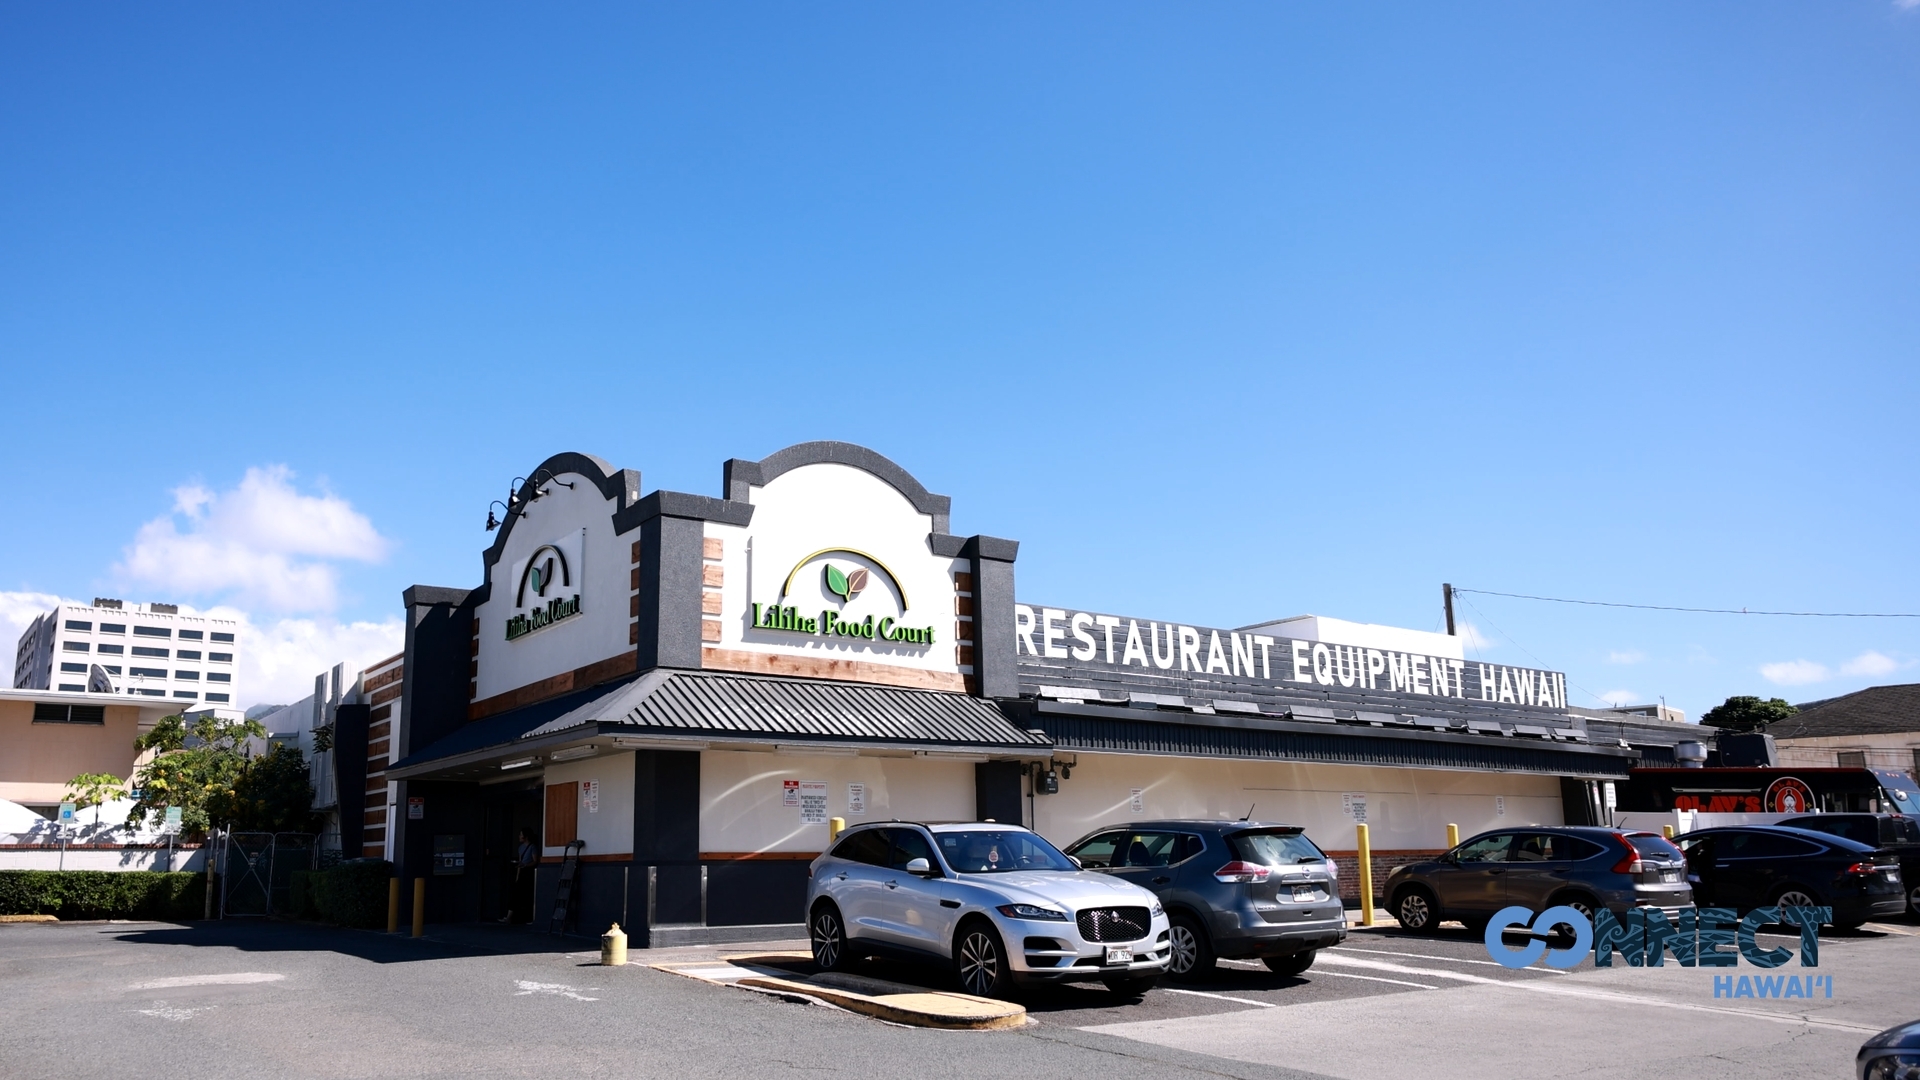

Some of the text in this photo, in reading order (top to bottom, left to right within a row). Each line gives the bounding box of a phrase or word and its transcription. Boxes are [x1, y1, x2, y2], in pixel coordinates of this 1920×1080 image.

[552, 594, 580, 621] Court
[752, 603, 936, 644] Liliha Food Court
[1014, 604, 1566, 709] RESTAURANT EQUIPMENT HAWAII
[1675, 795, 1761, 813] OLAY'S
